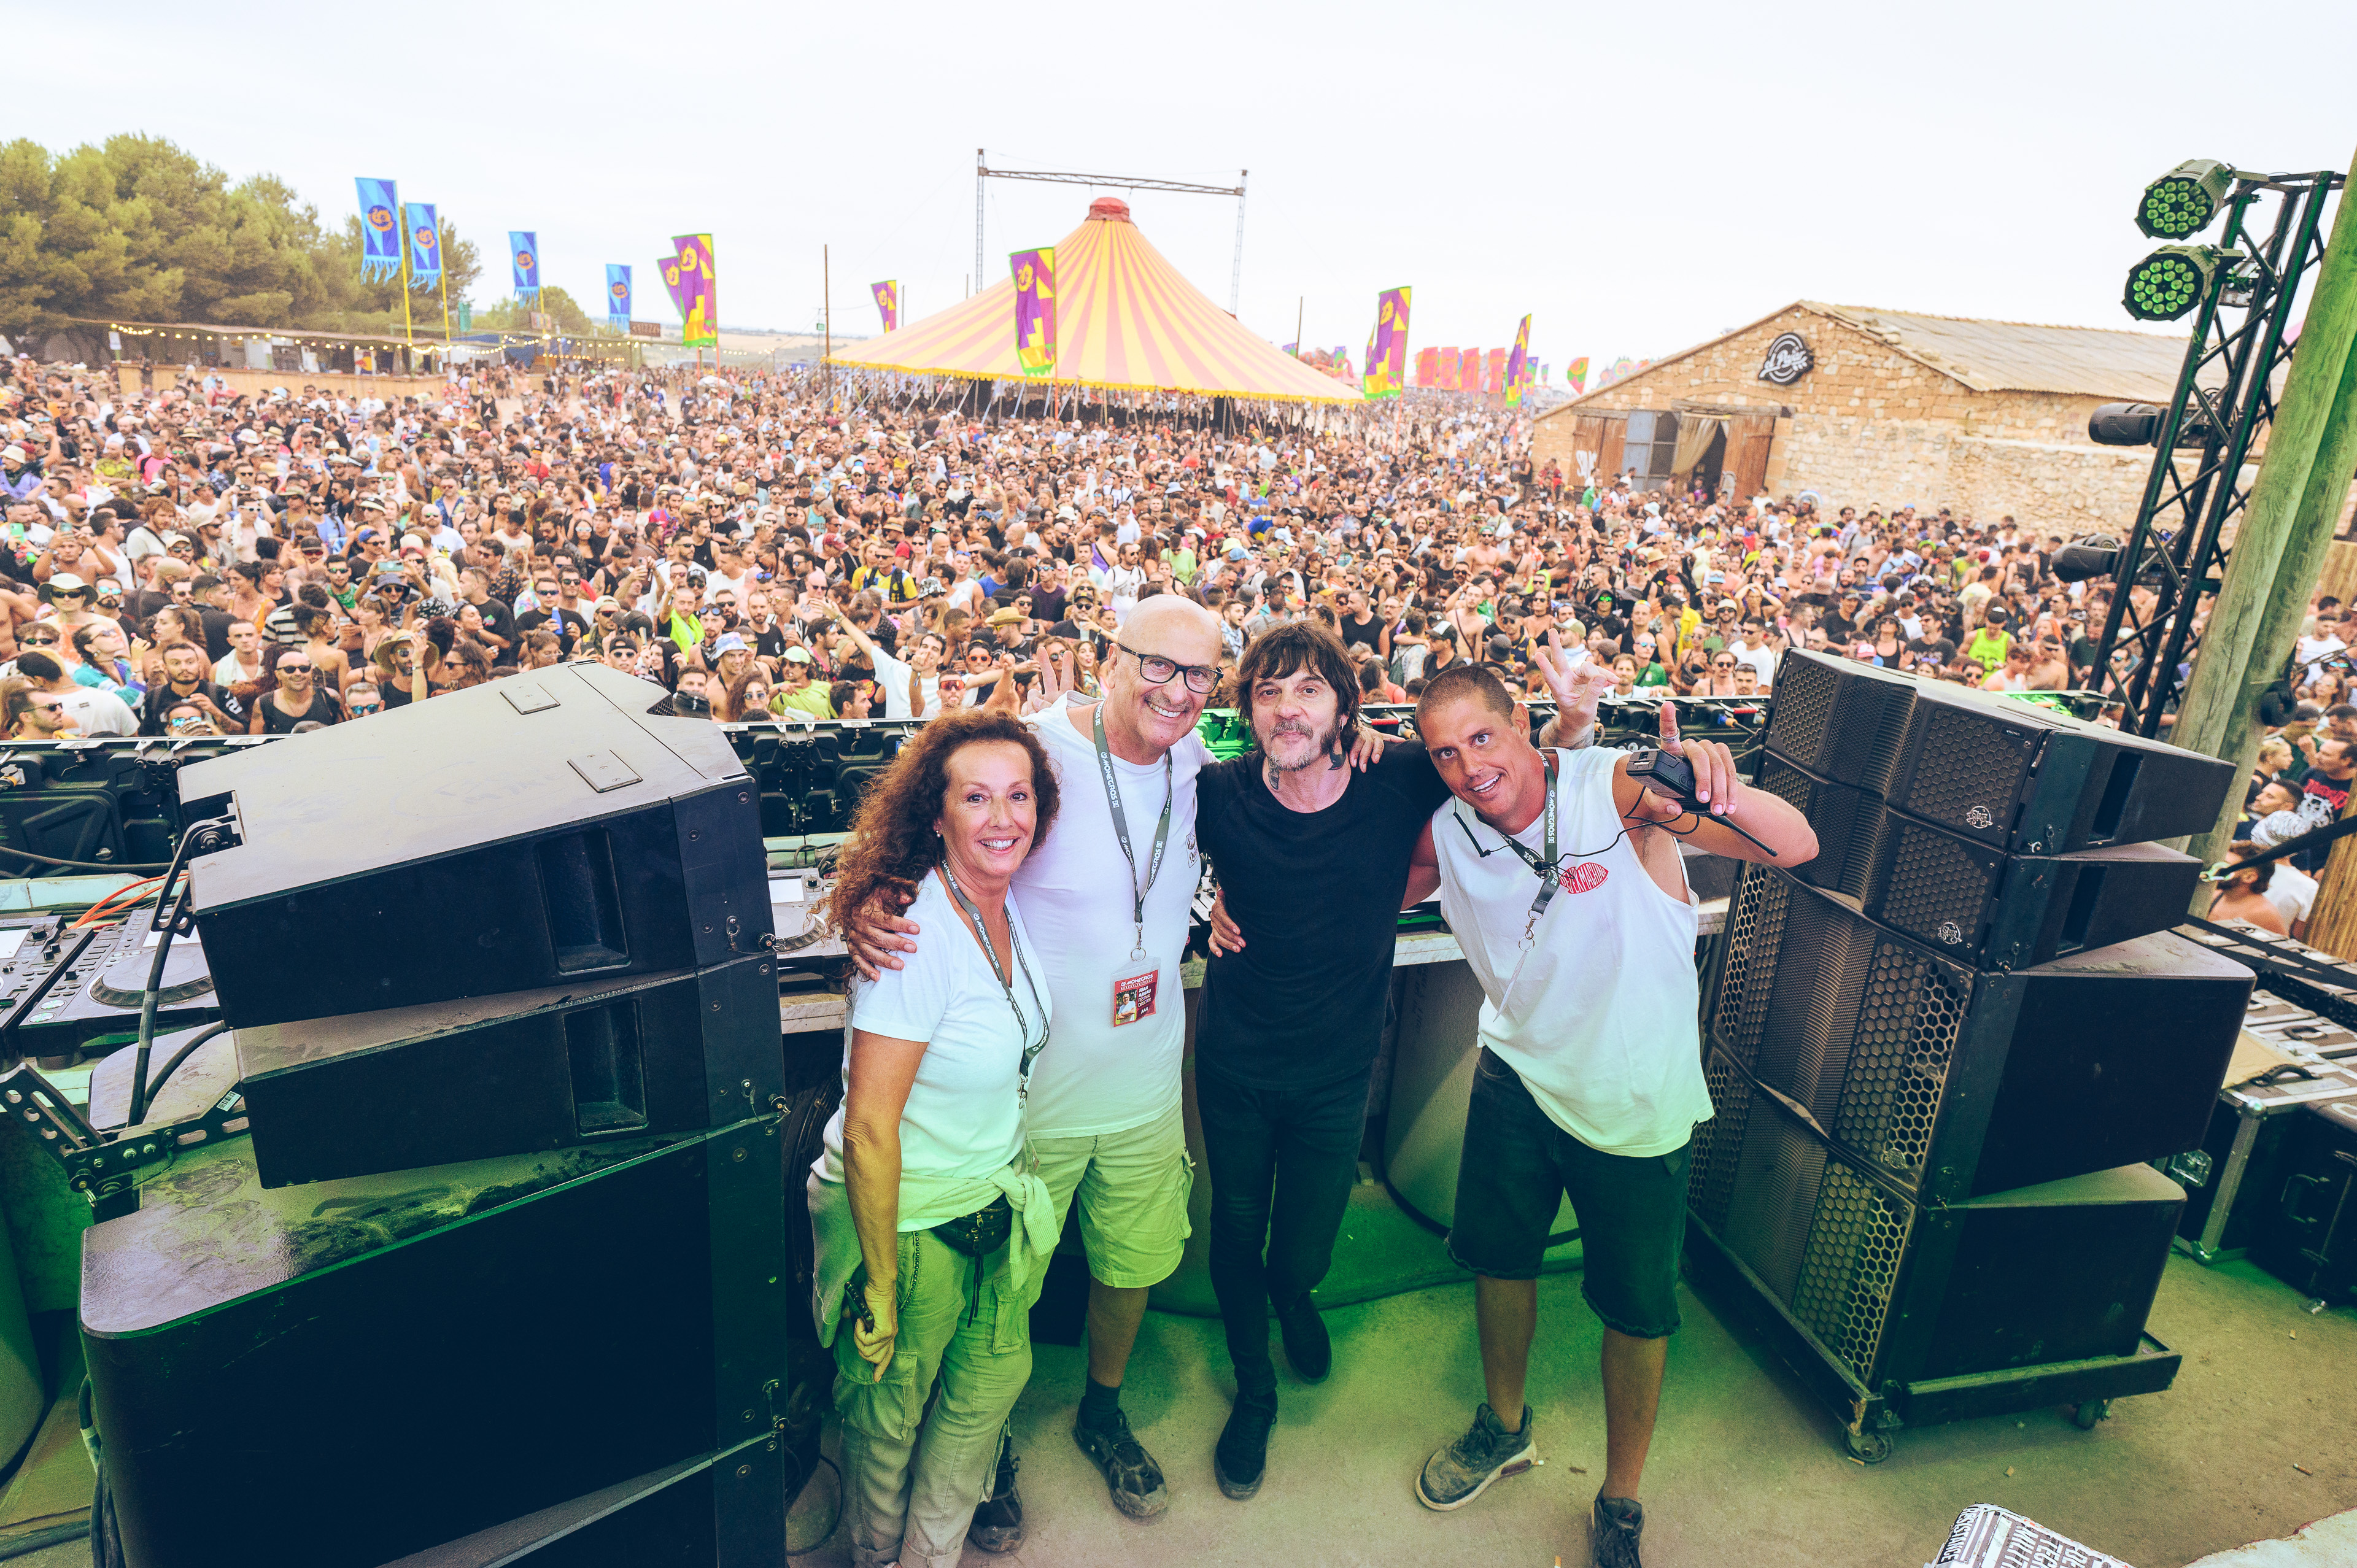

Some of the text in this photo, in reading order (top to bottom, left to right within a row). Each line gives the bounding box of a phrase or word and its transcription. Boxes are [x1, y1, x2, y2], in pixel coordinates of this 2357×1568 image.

[1102, 759, 1118, 800] MONEGROS
[1578, 863, 1608, 892] MACHINA
[976, 921, 996, 962] MONEGROS
[1126, 973, 1153, 986] MONEGROS
[1941, 1508, 1979, 1562] RESISTANCE
